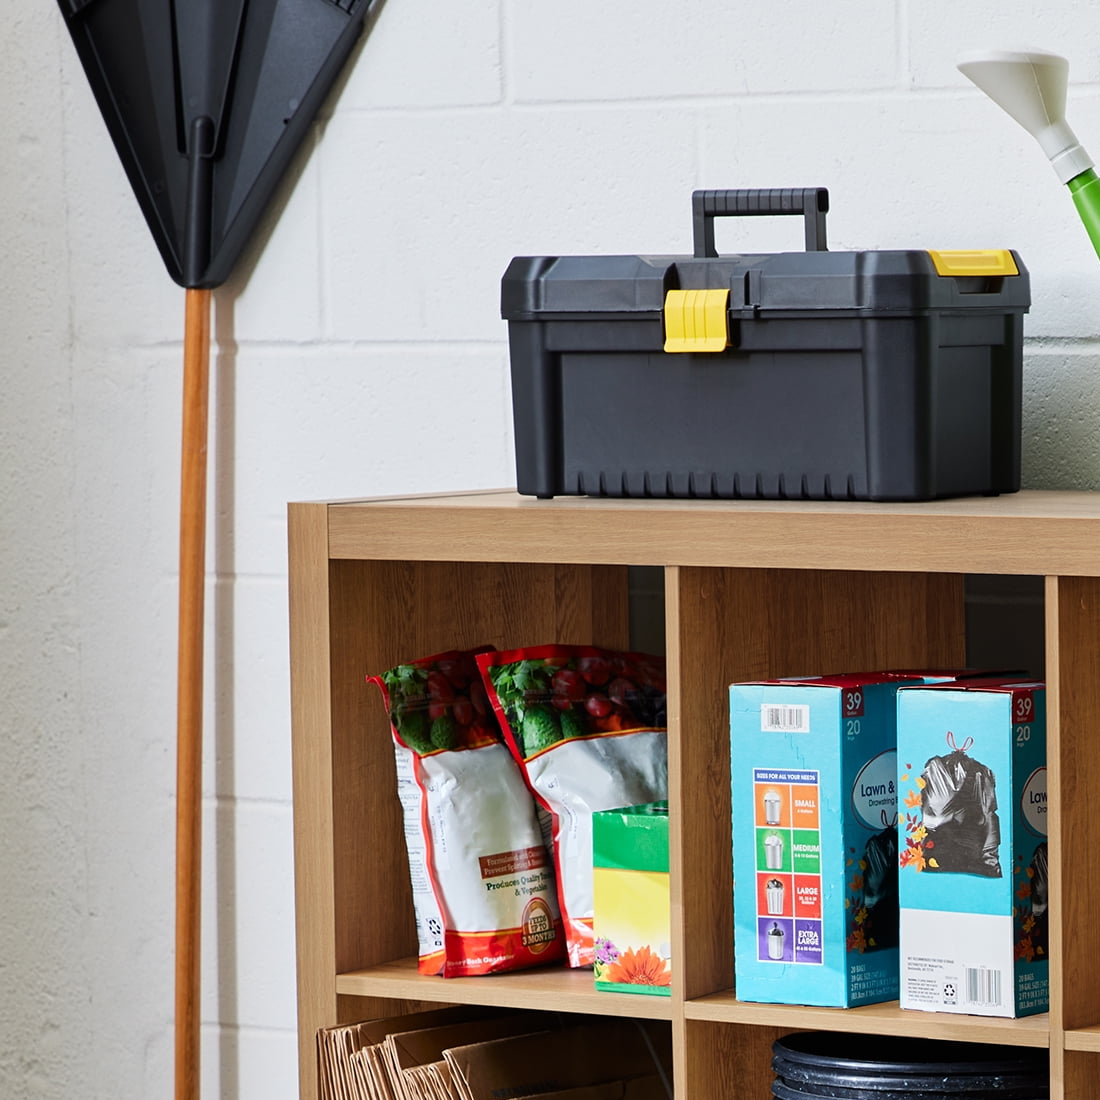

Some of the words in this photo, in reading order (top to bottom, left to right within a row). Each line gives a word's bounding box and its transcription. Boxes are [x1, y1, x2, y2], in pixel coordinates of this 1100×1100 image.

[847, 692, 862, 710] 39
[1017, 698, 1032, 716] 39
[847, 720, 861, 736] 20
[1017, 726, 1031, 741] 20
[861, 784, 886, 797] Lawn
[889, 781, 895, 794] &
[795, 800, 816, 808] SMALL
[869, 798, 895, 807] Drawstring
[486, 880, 520, 891] Produces
[522, 936, 528, 946] 3
[798, 937, 819, 945] LARGE
